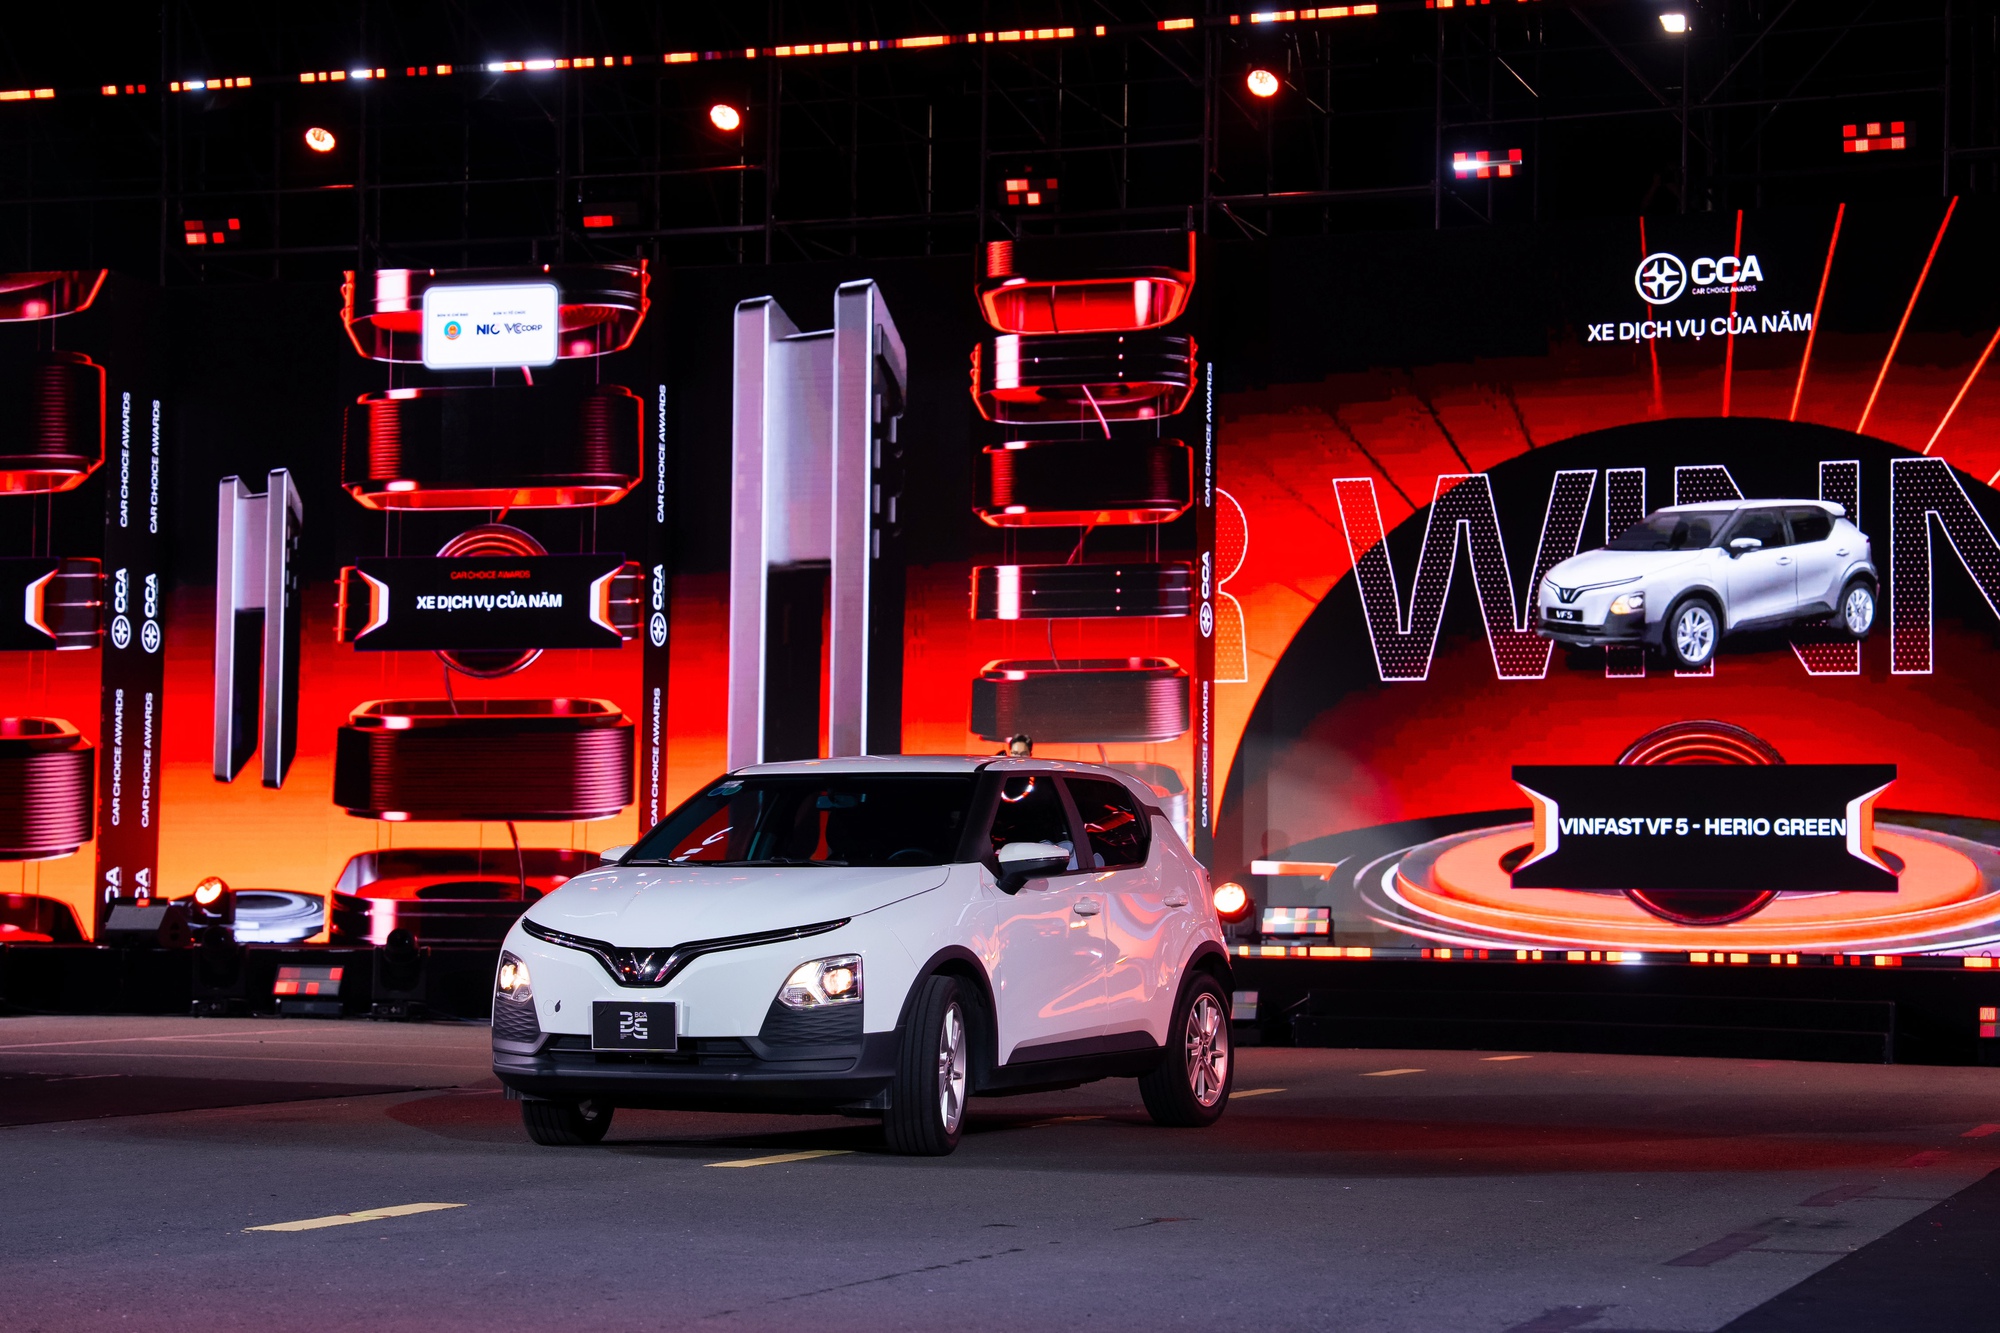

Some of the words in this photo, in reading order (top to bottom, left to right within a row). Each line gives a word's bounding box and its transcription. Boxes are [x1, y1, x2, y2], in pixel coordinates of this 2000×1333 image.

[1691, 254, 1763, 285] CCA
[1692, 287, 1706, 295] CAR
[1706, 286, 1730, 294] CHOICE
[1730, 284, 1756, 292] AWARDS
[476, 322, 500, 335] NIC
[1588, 324, 1614, 342] XE
[1620, 320, 1672, 344] DỊCH
[1675, 318, 1705, 341] VỤ
[1710, 311, 1757, 336] CỦA
[1762, 310, 1812, 333] NĂM
[122, 392, 130, 449] AWARDS
[152, 400, 160, 456] AWARDS
[121, 449, 130, 499] CHOICE
[150, 456, 159, 505] CHOICE
[658, 442, 666, 494] CHOICE
[120, 500, 128, 528] CAR
[150, 506, 158, 534] CAR
[114, 568, 127, 613] CCA
[144, 573, 156, 618] CCA
[450, 571, 467, 580] CAR
[467, 570, 496, 580] CHOICE
[497, 570, 531, 579] AWARDS
[652, 564, 664, 611] CCA
[1202, 551, 1210, 599] CCA
[416, 596, 435, 609] XE
[437, 595, 473, 612] DỊCH
[474, 595, 495, 612] VỤ
[496, 590, 528, 609] CỦA
[529, 591, 562, 608] NĂM
[114, 688, 124, 746] AWARDS
[144, 692, 153, 749] AWARDS
[653, 687, 661, 746] AWARDS
[112, 746, 122, 797] CHOICE
[142, 749, 152, 799] CHOICE
[651, 746, 660, 798] CHOICE
[112, 797, 120, 826] CAR
[141, 800, 150, 828] CAR
[1559, 817, 1644, 836] VINFAST
[1646, 817, 1673, 836] VF
[1675, 817, 1689, 836] 5
[1704, 817, 1769, 836] HERIO
[1773, 817, 1846, 836] GREEN
